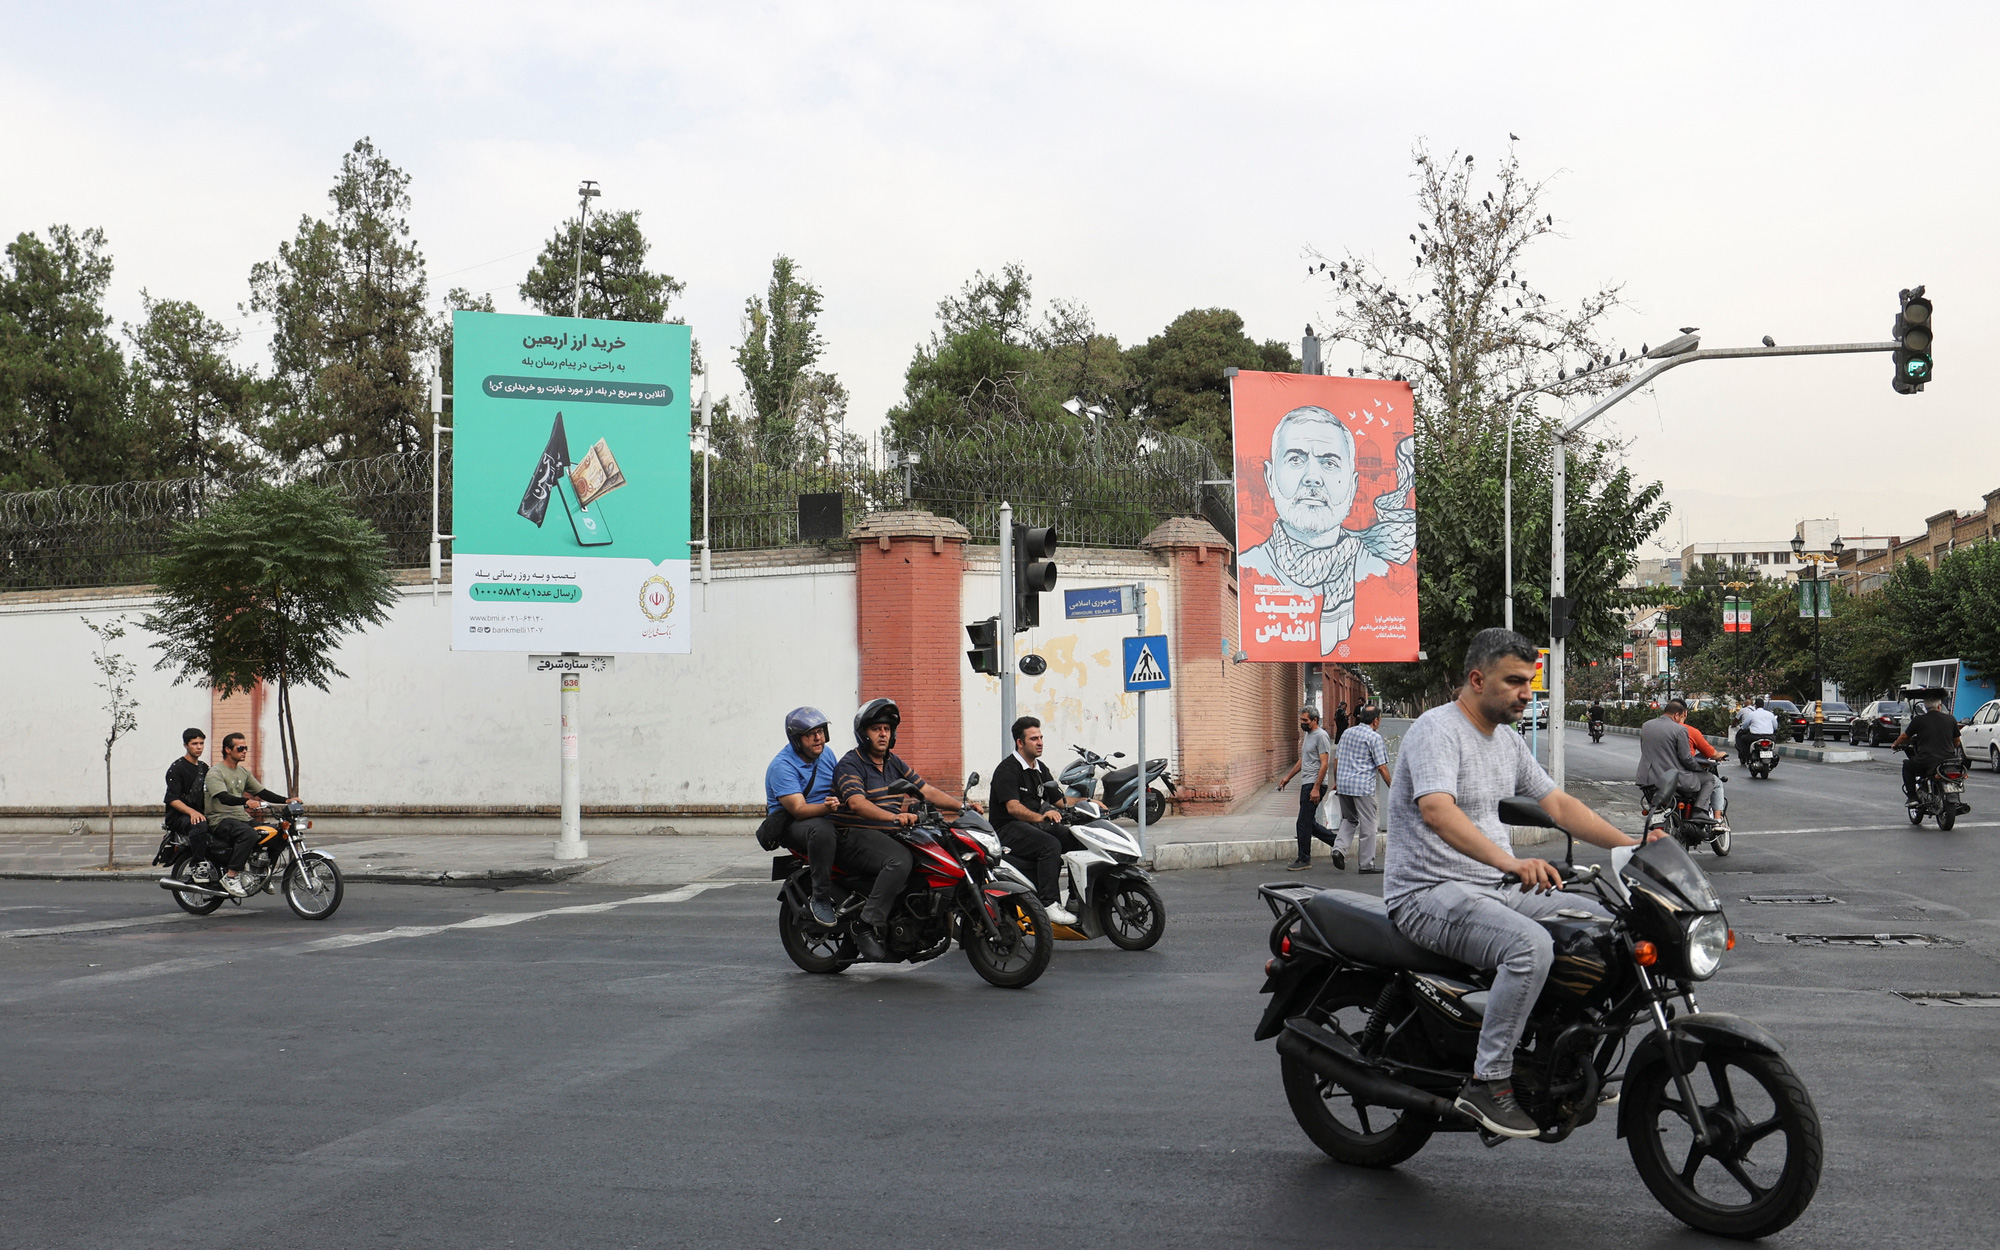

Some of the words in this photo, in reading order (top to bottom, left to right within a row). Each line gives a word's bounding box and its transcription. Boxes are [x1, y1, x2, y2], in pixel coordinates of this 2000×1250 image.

[522, 332, 567, 350] اربعین
[570, 333, 587, 351] ارز
[591, 336, 626, 353] خرید
[522, 356, 534, 368] بله
[536, 356, 558, 370] رسان
[559, 358, 576, 370] پیام
[578, 361, 587, 371] در
[588, 361, 614, 372] راحتی
[616, 363, 626, 372] به
[489, 380, 503, 392] کن!
[504, 382, 536, 394] خریداری
[546, 384, 566, 394] نیازت
[567, 386, 584, 396] مورد
[584, 386, 594, 396] ارز
[608, 389, 616, 398] در
[618, 389, 637, 398] سریع
[644, 390, 666, 400] آنلاین
[474, 569, 490, 580] بله
[546, 574, 550, 582] و
[522, 590, 530, 598] به
[553, 588, 577, 600] ارسال
[1068, 600, 1090, 610] اسلامی
[1091, 599, 1116, 608] جمهوری
[1256, 619, 1316, 642] القدس
[536, 659, 564, 670] شرقی
[564, 658, 588, 670] ستاره
[1415, 982, 1440, 1003] HLX
[1441, 1000, 1462, 1017] 150
